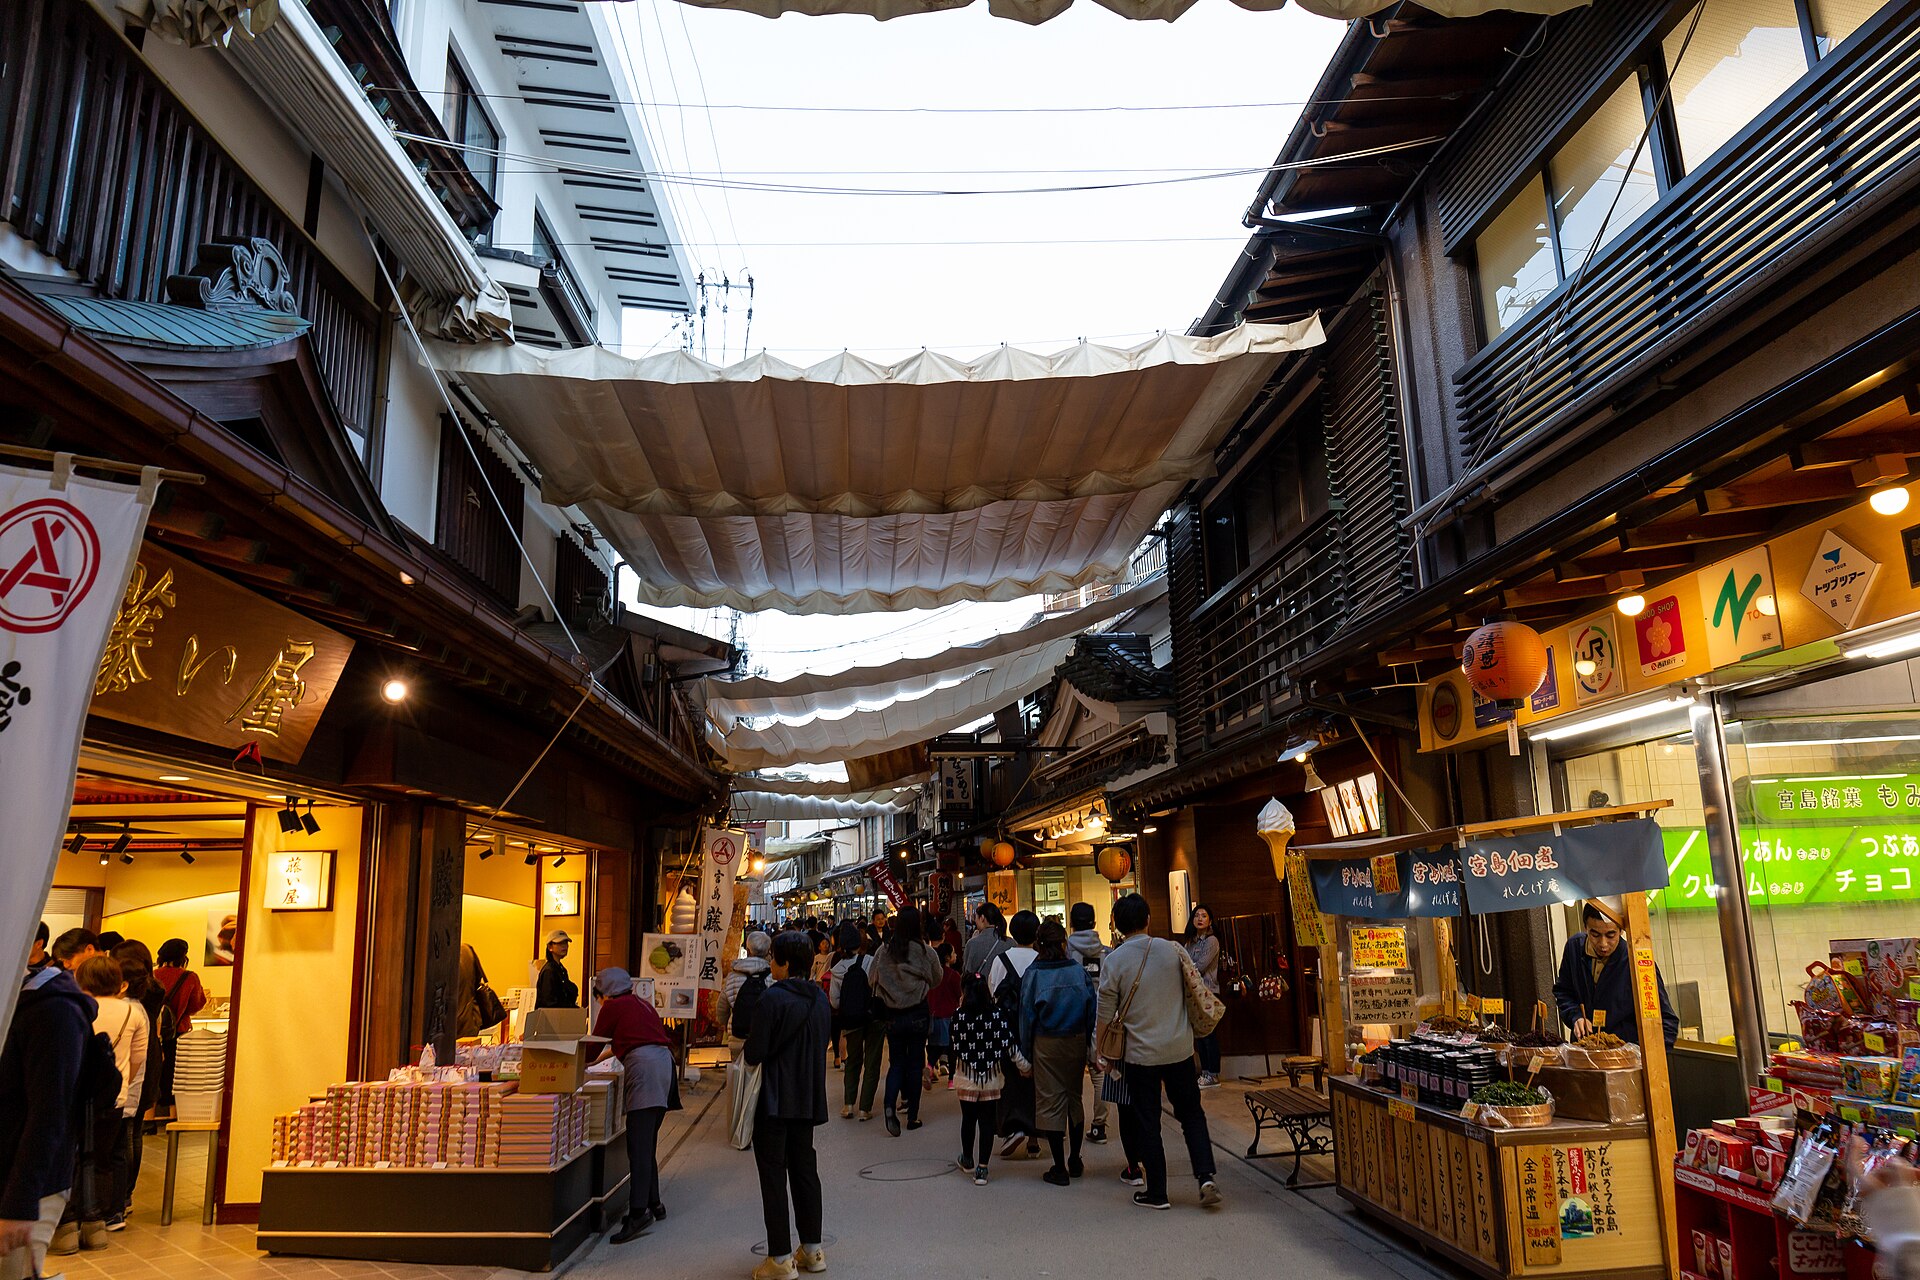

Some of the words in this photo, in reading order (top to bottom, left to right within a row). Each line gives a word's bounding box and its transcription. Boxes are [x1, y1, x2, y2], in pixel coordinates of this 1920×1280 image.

[1825, 562, 1847, 574] TOPTOUR
[1815, 570, 1866, 597] トップツアー
[1657, 601, 1675, 614] SHOP
[1830, 594, 1853, 608] 協定
[1747, 608, 1765, 622] TO
[1581, 637, 1605, 661] JR
[1778, 787, 1863, 810] 宮島銘菓
[1467, 845, 1559, 878] 宮島佃煮
[1796, 847, 1832, 861] もみじ
[282, 856, 302, 904] 藤い屋
[1502, 877, 1561, 899] れんげ庵
[1769, 881, 1805, 895] もみじ
[1835, 867, 1913, 893] チョコ
[1541, 1154, 1556, 1210] 宮島みやげ
[1553, 1148, 1570, 1199] 今から本番
[1475, 1152, 1491, 1245] しそわかめ
[1523, 1157, 1540, 1220] 全品常温
[1598, 1143, 1618, 1232] がんばろう広島
